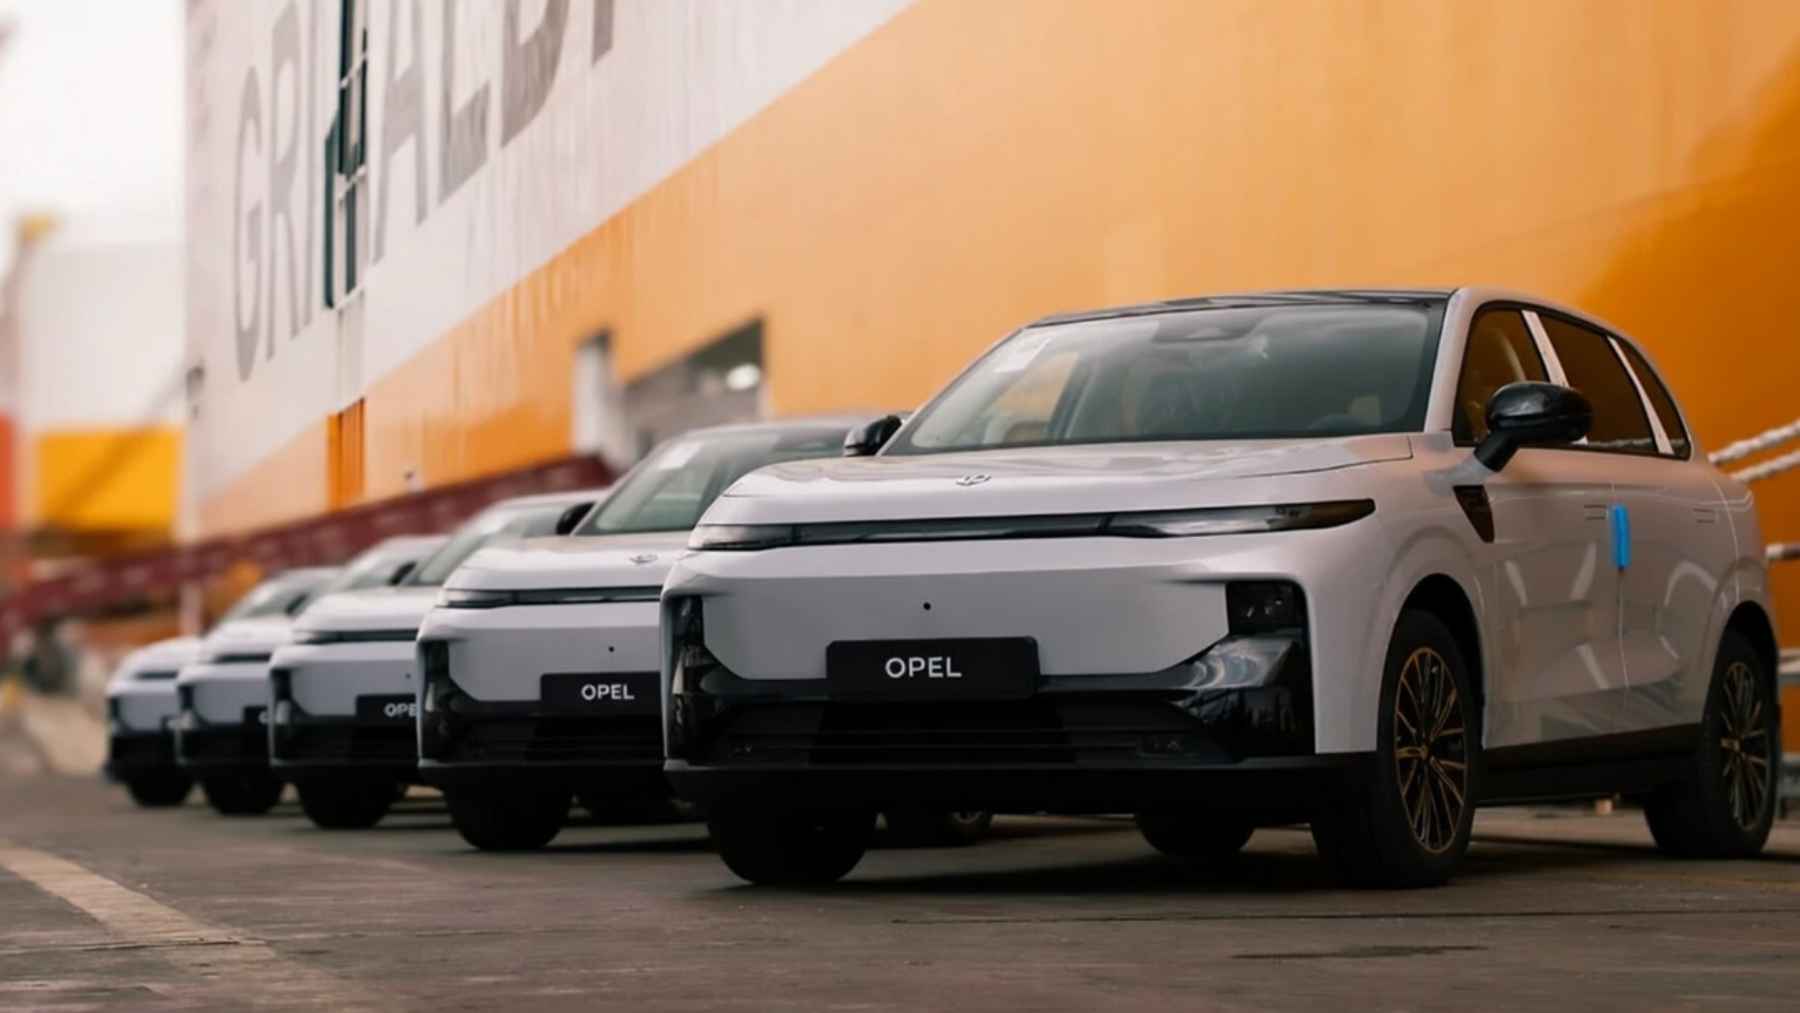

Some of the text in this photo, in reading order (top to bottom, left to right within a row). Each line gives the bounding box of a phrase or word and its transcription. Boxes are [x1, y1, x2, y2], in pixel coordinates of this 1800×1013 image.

[885, 656, 963, 678] OPEL
[581, 683, 635, 701] OPEL
[384, 702, 417, 718] OPE
